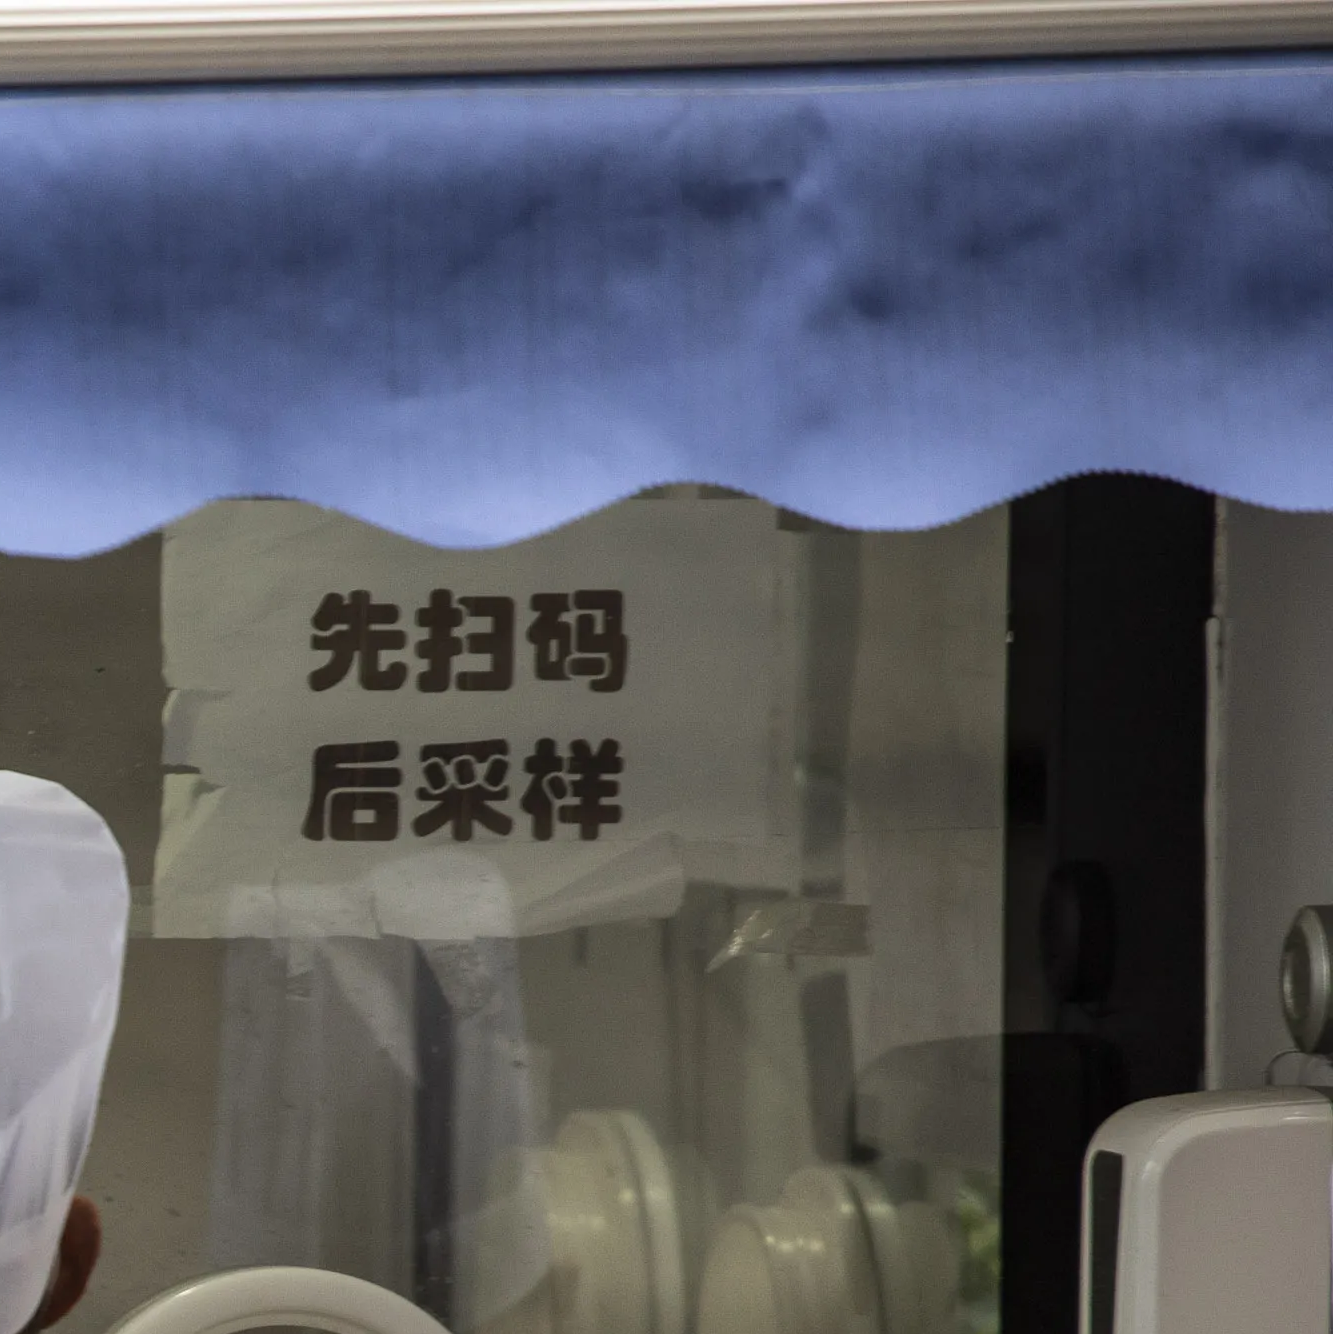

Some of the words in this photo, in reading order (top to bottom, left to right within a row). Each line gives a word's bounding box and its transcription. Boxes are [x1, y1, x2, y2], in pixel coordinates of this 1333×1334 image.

[306, 588, 629, 693] 先扫码
[301, 738, 623, 841] 后采样
